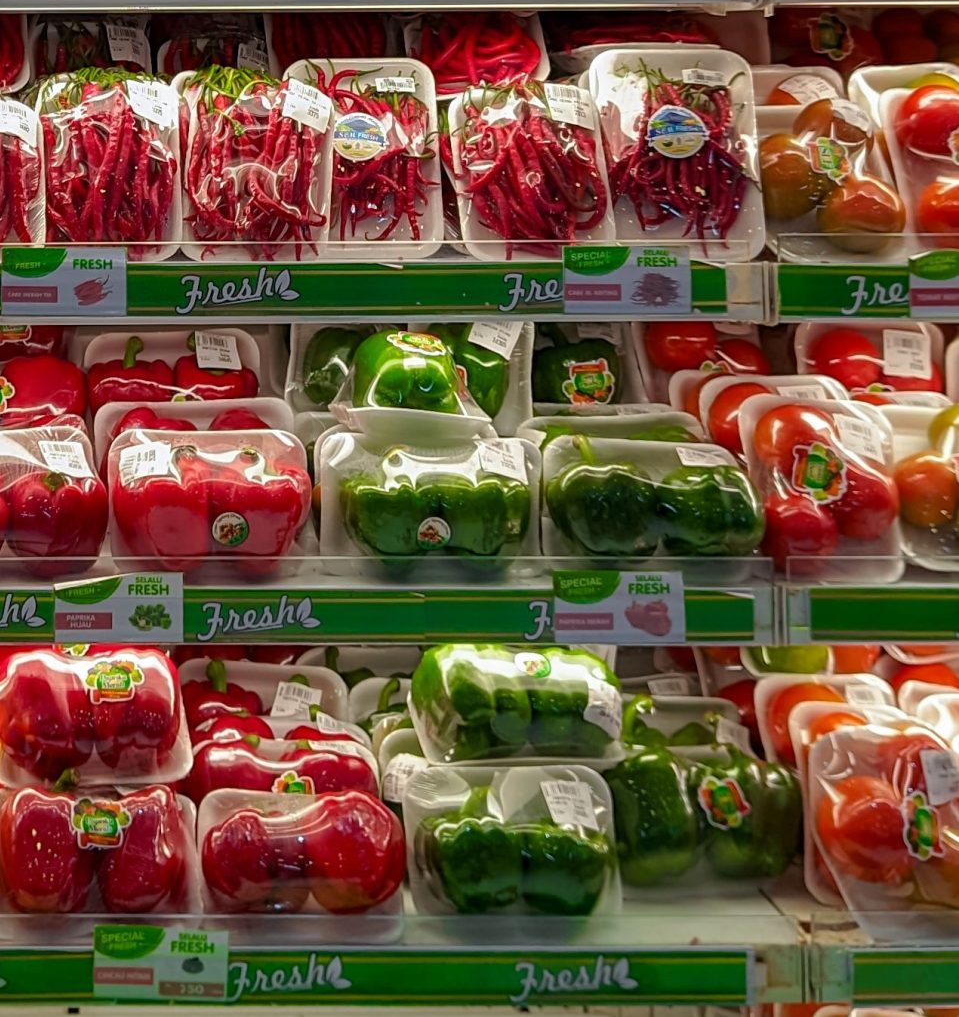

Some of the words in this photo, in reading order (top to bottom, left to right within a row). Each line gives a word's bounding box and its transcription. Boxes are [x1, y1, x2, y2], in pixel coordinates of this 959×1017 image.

[571, 252, 610, 262] SPECIAL
[636, 256, 677, 267] FRESH
[72, 259, 112, 270] FRESH
[176, 267, 274, 314] Fresh
[498, 273, 563, 312] Fre
[840, 275, 908, 314] Fre
[560, 577, 602, 589] SPECIAL
[628, 583, 671, 595] FRESH
[66, 588, 95, 597] FRESH
[128, 585, 169, 596] FRESH
[197, 595, 298, 641] Fresh
[101, 932, 145, 943] SPECIAL
[171, 941, 215, 954] FRESH
[226, 953, 326, 1001] Fresh
[510, 956, 613, 1002] Fresh
